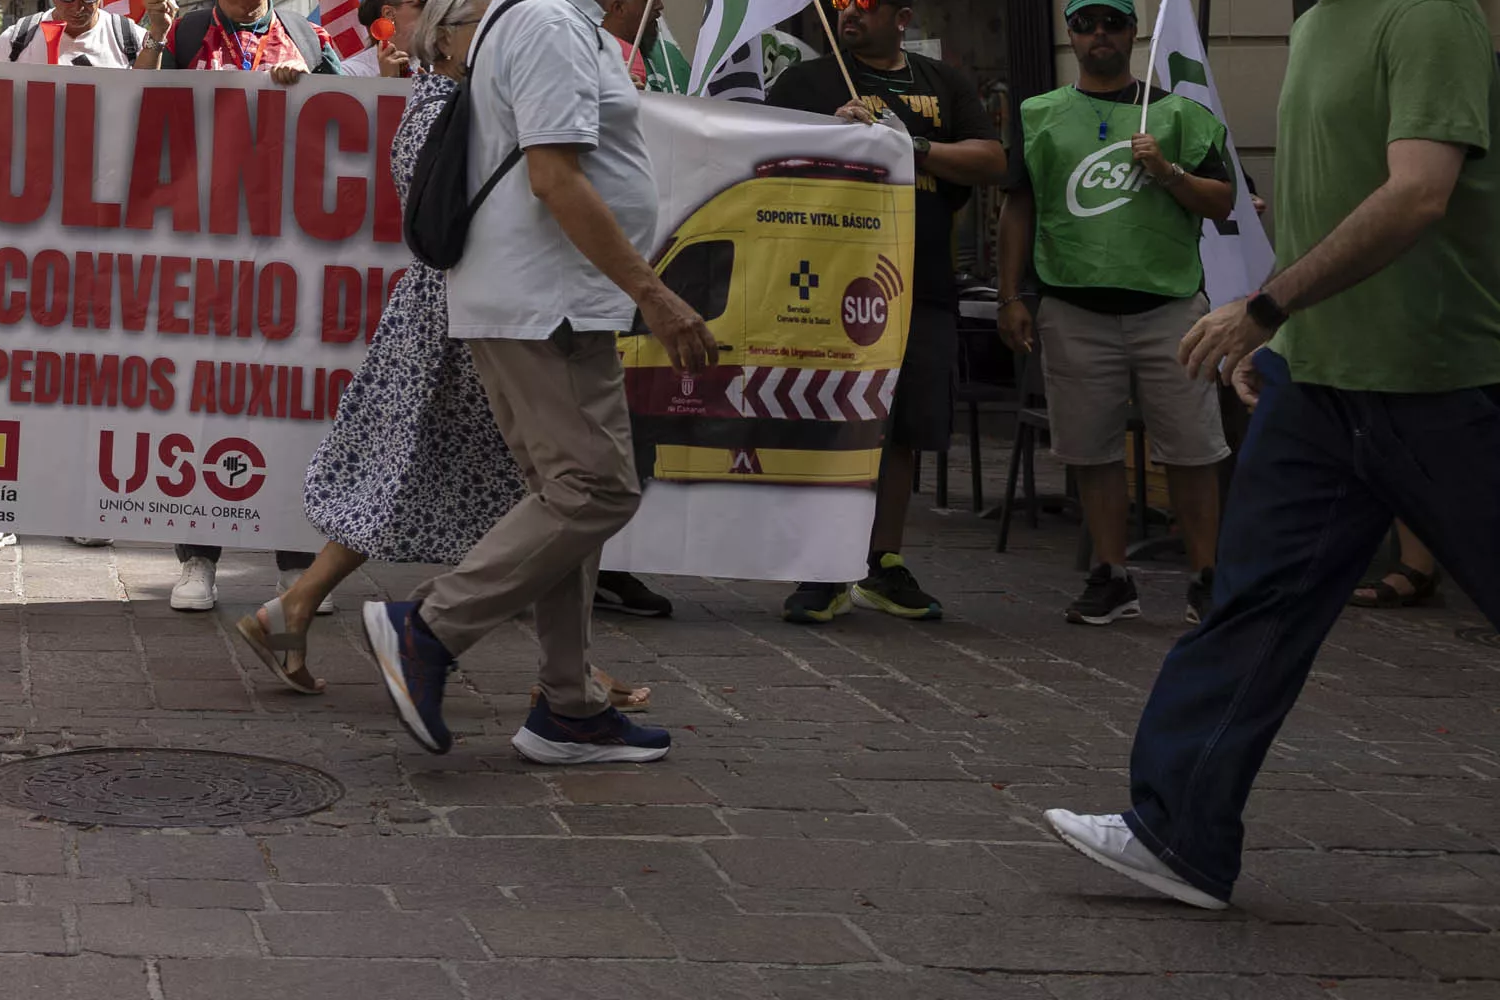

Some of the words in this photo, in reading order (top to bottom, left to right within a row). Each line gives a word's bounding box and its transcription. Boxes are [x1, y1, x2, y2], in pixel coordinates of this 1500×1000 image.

[756, 210, 807, 225] SOPORTE
[810, 212, 839, 227] VITAL
[842, 213, 881, 230] BÁSICO
[844, 296, 886, 325] SUC
[99, 430, 267, 501] USO
[100, 496, 144, 513] UNIÓN
[148, 501, 207, 518] SINDICAL
[211, 506, 260, 521] OBRERA
